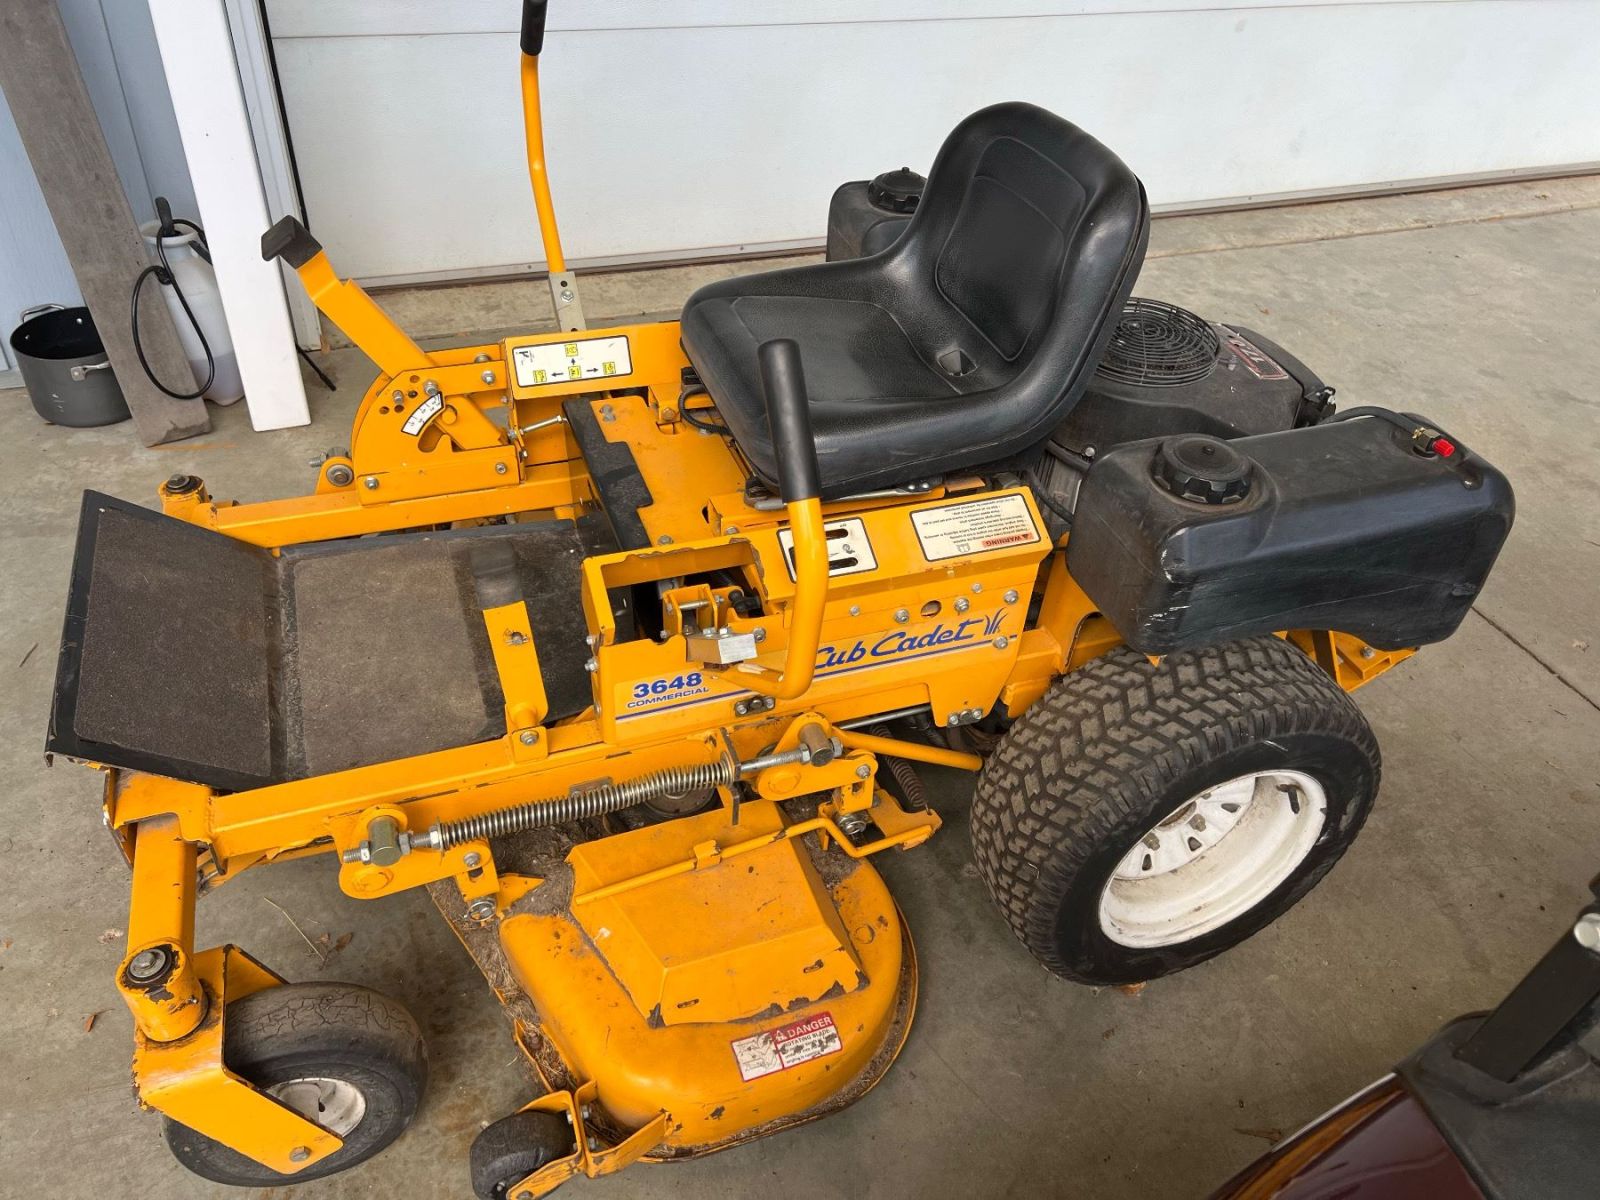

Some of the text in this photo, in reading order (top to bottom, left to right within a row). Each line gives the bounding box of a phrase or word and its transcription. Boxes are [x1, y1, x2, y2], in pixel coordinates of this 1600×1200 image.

[985, 535, 1021, 547] WARNING
[814, 618, 984, 670] Cub Cadet
[633, 672, 702, 698] 3648
[627, 686, 710, 708] COMMERCIAL
[787, 1016, 833, 1038] DANGER
